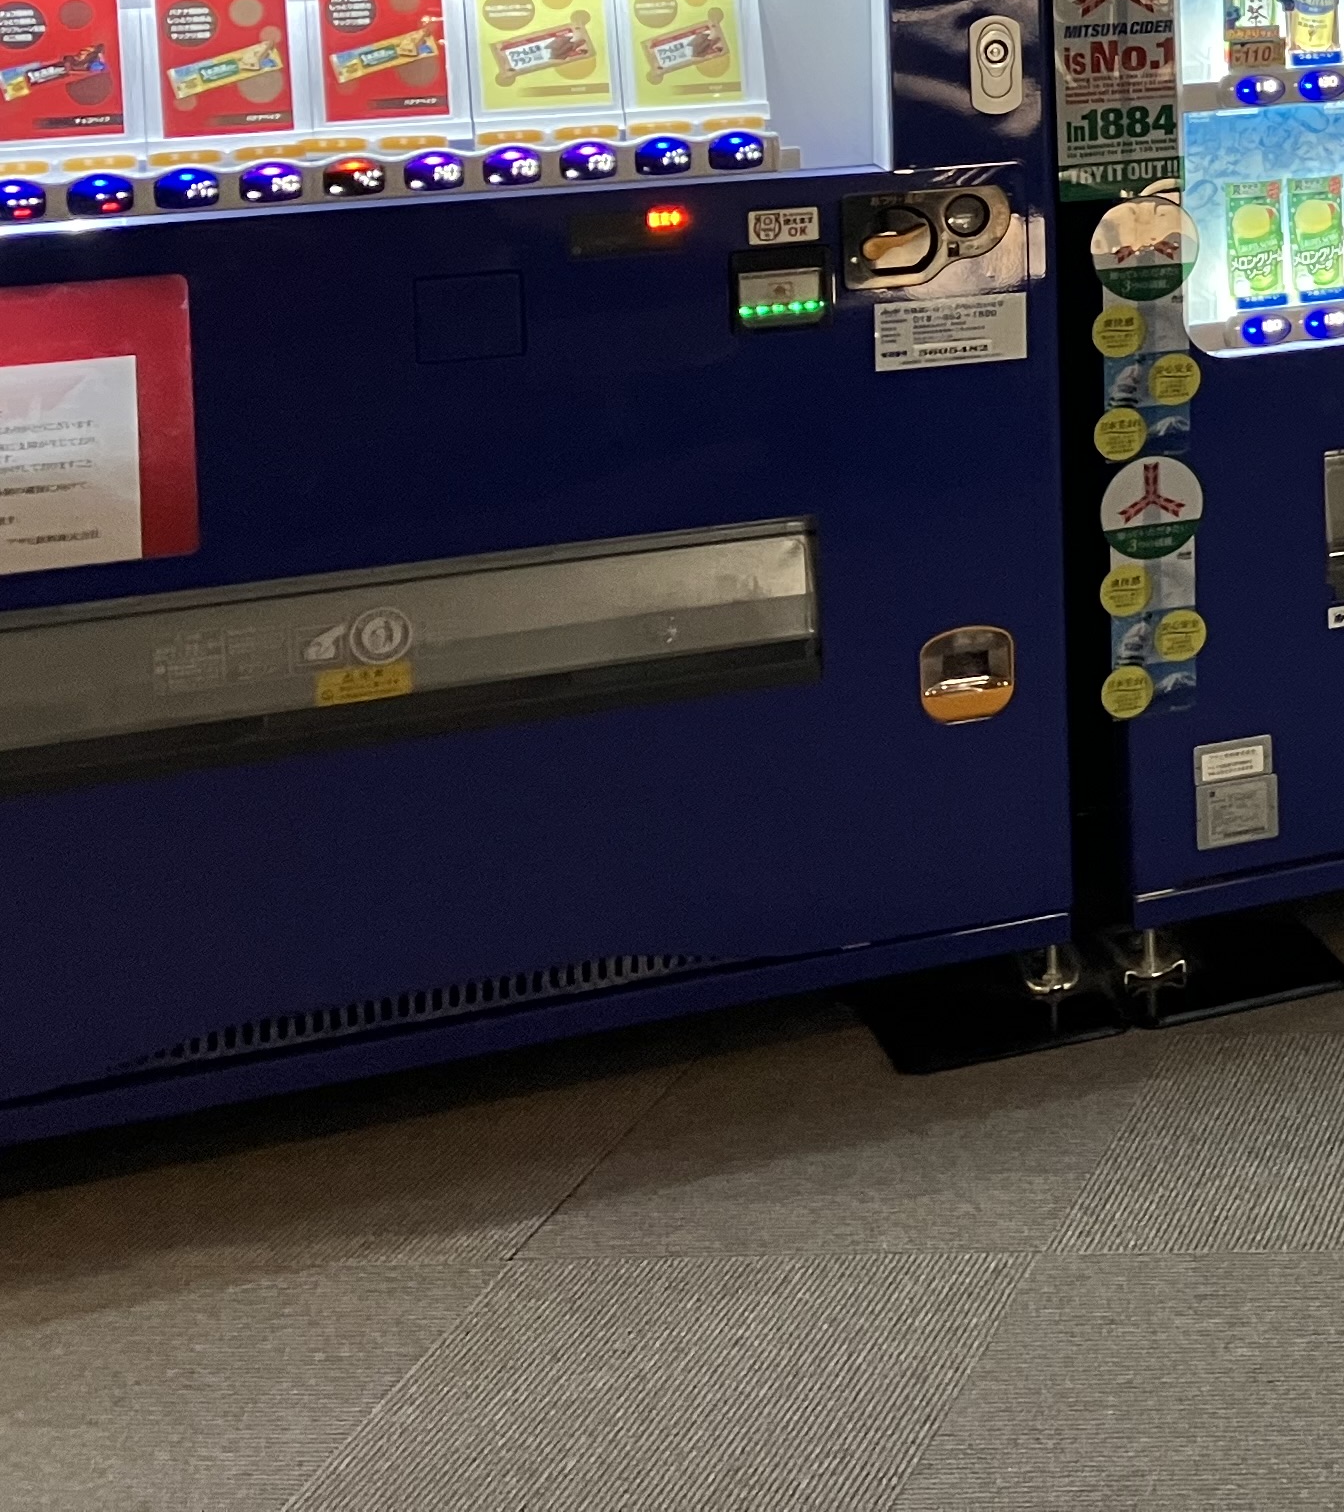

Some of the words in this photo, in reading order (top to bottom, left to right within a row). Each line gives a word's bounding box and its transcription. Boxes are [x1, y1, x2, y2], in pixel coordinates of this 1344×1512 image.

[1064, 22, 1128, 39] MITSUYA
[1129, 19, 1174, 35] CIDER
[1063, 46, 1087, 76] is
[1090, 36, 1176, 74] No.1
[1066, 121, 1086, 144] In
[1081, 104, 1177, 142] 1884
[1107, 164, 1124, 183] IT
[787, 225, 808, 237] OK
